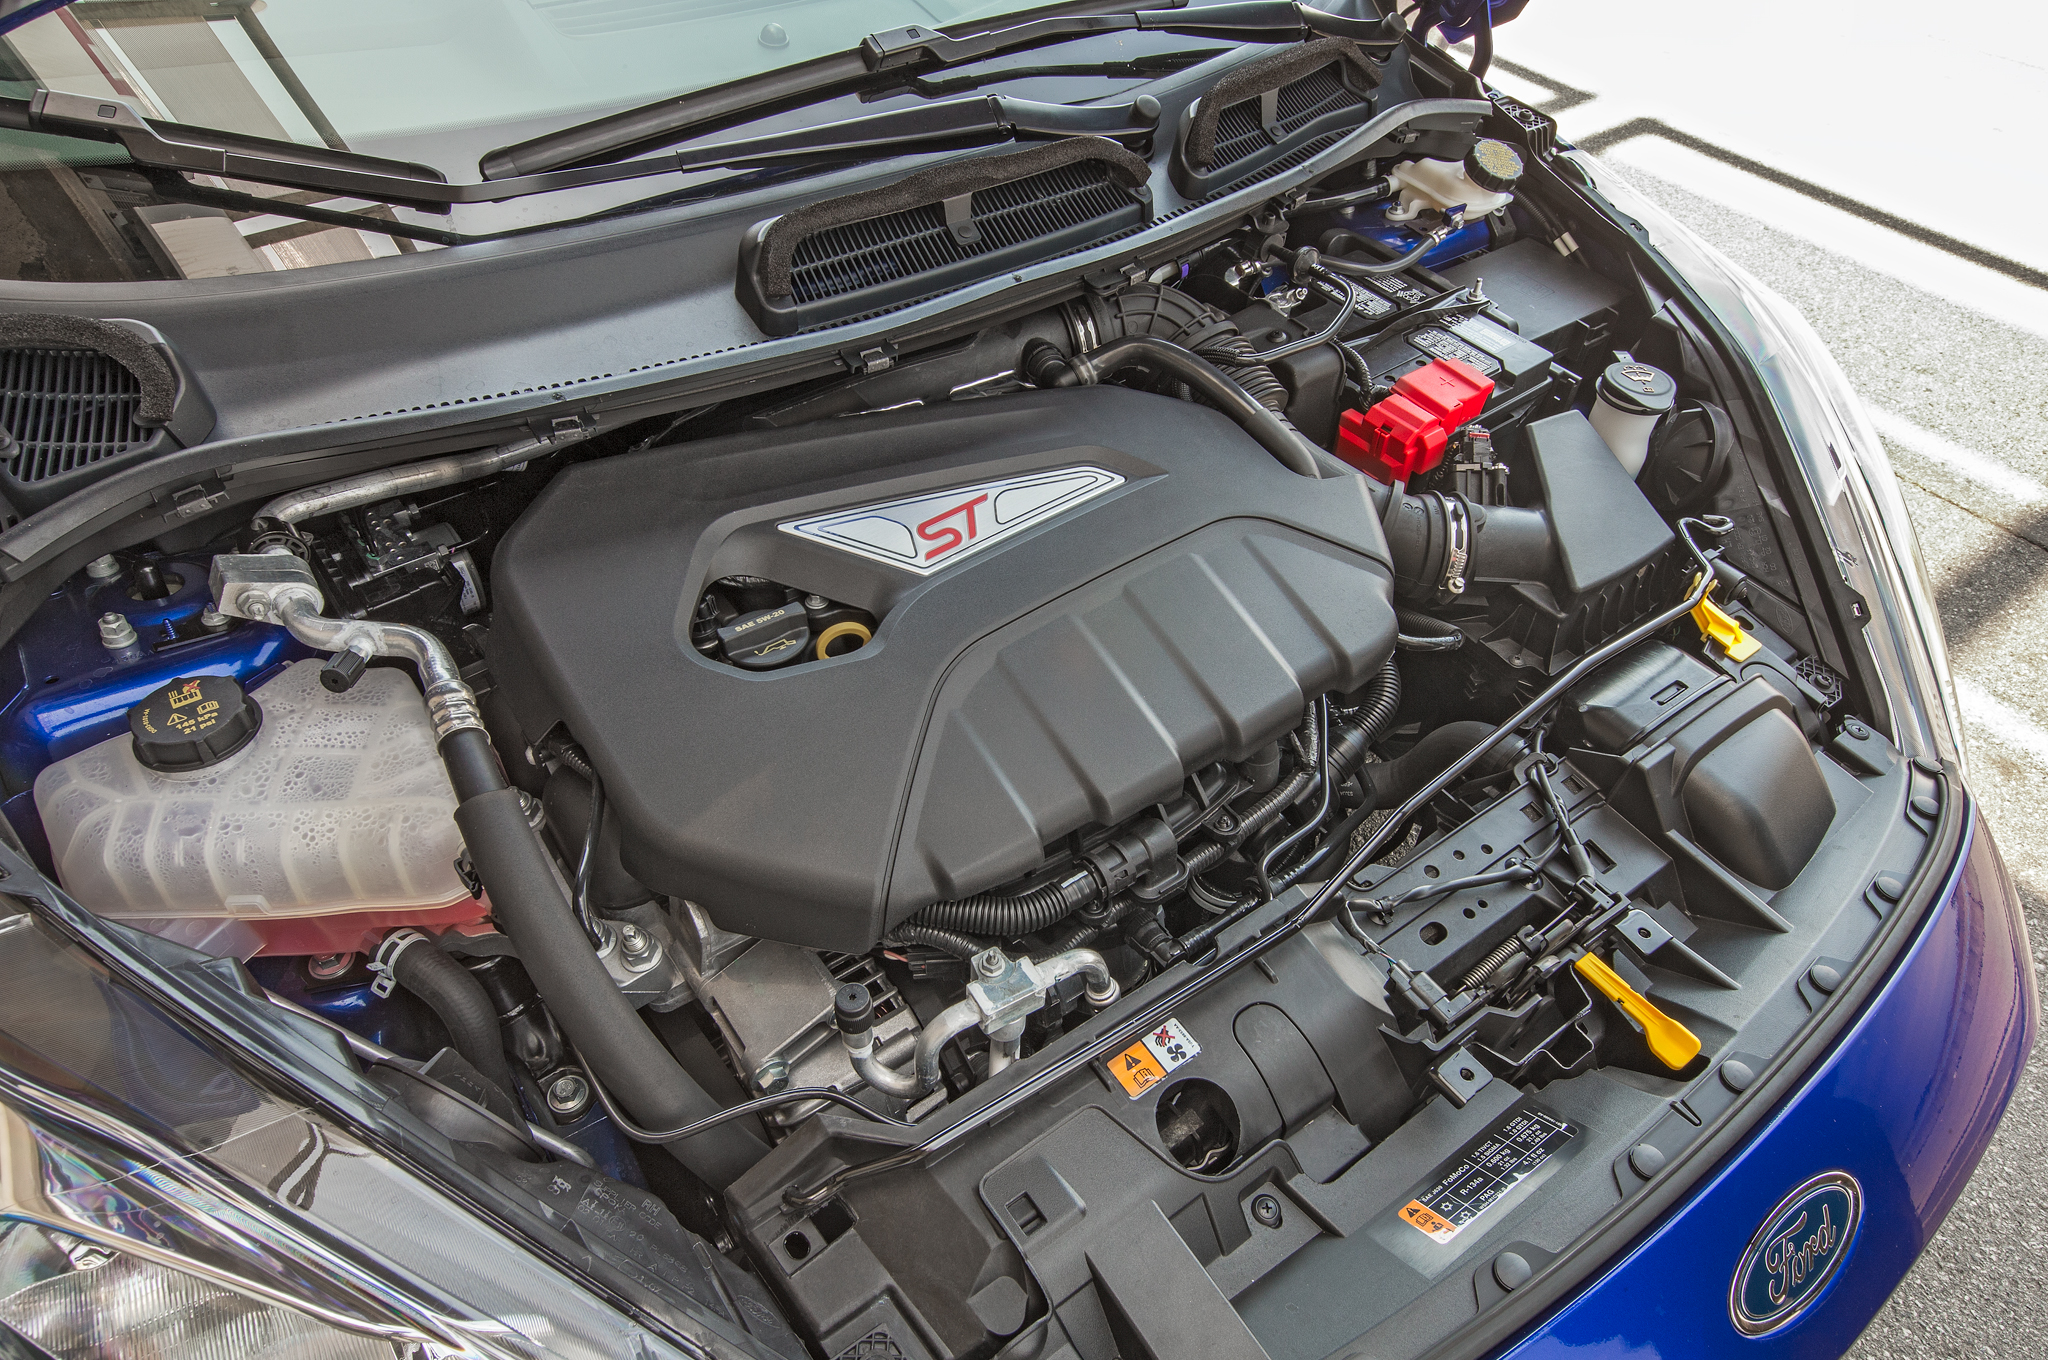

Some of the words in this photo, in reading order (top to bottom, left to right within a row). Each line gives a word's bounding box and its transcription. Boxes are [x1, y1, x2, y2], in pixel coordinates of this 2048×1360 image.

[917, 492, 989, 562] ST
[734, 621, 756, 633] SAE
[756, 609, 785, 625] 5W-20
[175, 718, 195, 730] 145
[197, 711, 219, 723] kPa
[183, 725, 197, 735] 21
[199, 718, 217, 731] psi
[1529, 1122, 1540, 1131] kg
[1499, 1147, 1510, 1155] kg
[1421, 1192, 1433, 1202] SAE
[1442, 1163, 1470, 1186] FoMoCo
[1460, 1175, 1483, 1195] R-134a
[592, 1178, 638, 1212] SUPPLIER
[1479, 1188, 1494, 1201] PAG
[640, 1197, 661, 1216] RH
[1765, 1203, 1837, 1305] Ford
